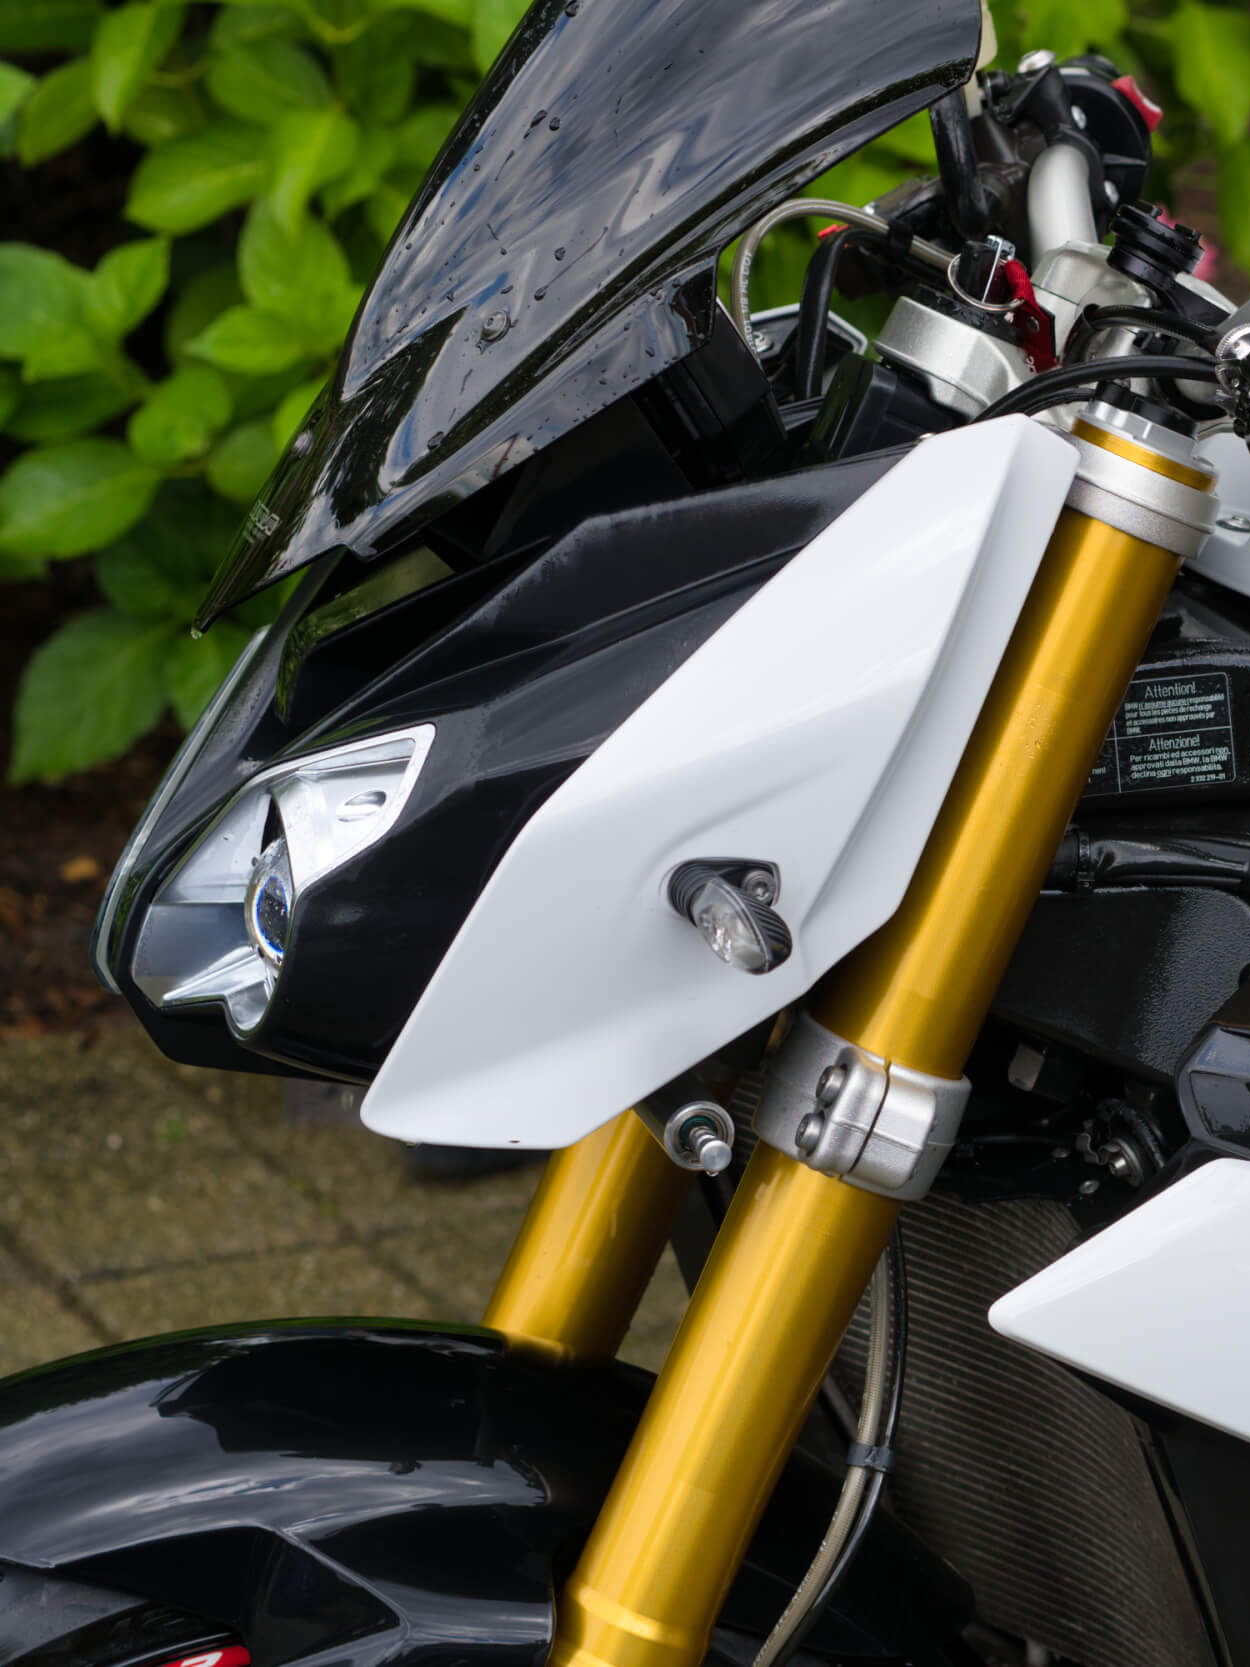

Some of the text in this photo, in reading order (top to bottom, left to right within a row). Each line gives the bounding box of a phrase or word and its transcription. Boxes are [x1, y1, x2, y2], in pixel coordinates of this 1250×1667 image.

[742, 248, 752, 275] DOT
[1144, 681, 1196, 699] Attention!
[1149, 733, 1201, 751] Attenzione!
[1129, 754, 1142, 763] Per
[1143, 751, 1170, 761] ricambi
[1171, 750, 1180, 758] ed
[1181, 747, 1215, 757] accessori
[1130, 760, 1165, 771] approvati
[1164, 758, 1183, 767] dalla
[1130, 769, 1157, 779] declina
[1156, 768, 1172, 778] ogni
